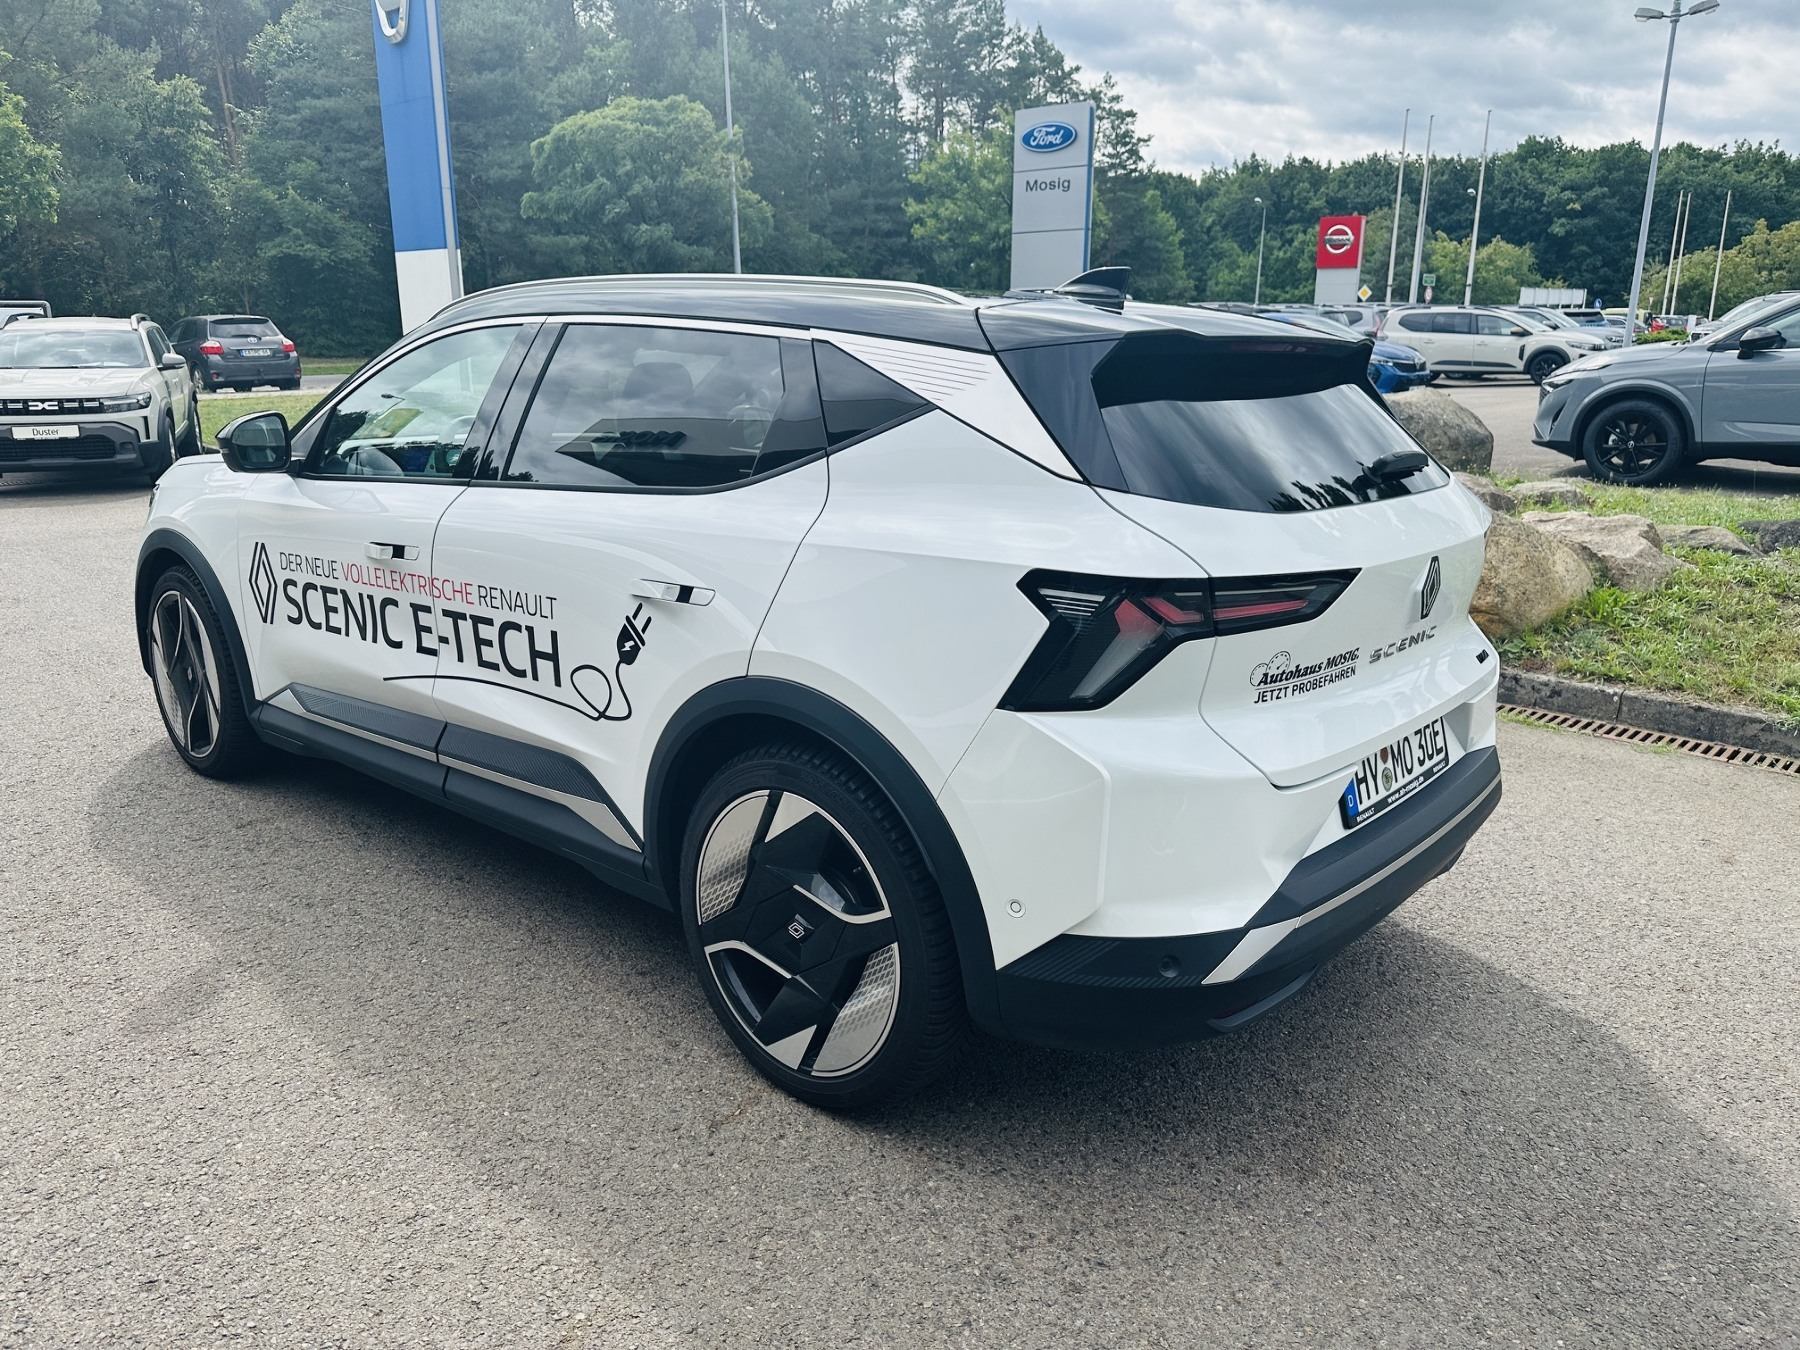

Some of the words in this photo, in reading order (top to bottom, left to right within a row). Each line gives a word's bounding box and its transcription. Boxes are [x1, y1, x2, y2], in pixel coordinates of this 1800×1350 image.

[1030, 126, 1064, 146] Ford
[1025, 177, 1071, 193] Mosig
[32, 428, 59, 436] Duster
[279, 551, 303, 573] DER
[305, 556, 339, 580] NEUE
[340, 561, 475, 606] VOLLELEKTRISCHE
[477, 584, 557, 620] RENAULT
[282, 578, 403, 650] SCENIC
[409, 602, 562, 688] E-TECH
[1369, 625, 1437, 665] SCENIC
[1253, 686, 1290, 704] JETZT
[1291, 665, 1356, 696] PROBEFAHREN
[1256, 662, 1324, 687] Autohaus
[1354, 752, 1379, 806] HY
[1389, 735, 1414, 784] MO
[1414, 718, 1444, 767] 30E
